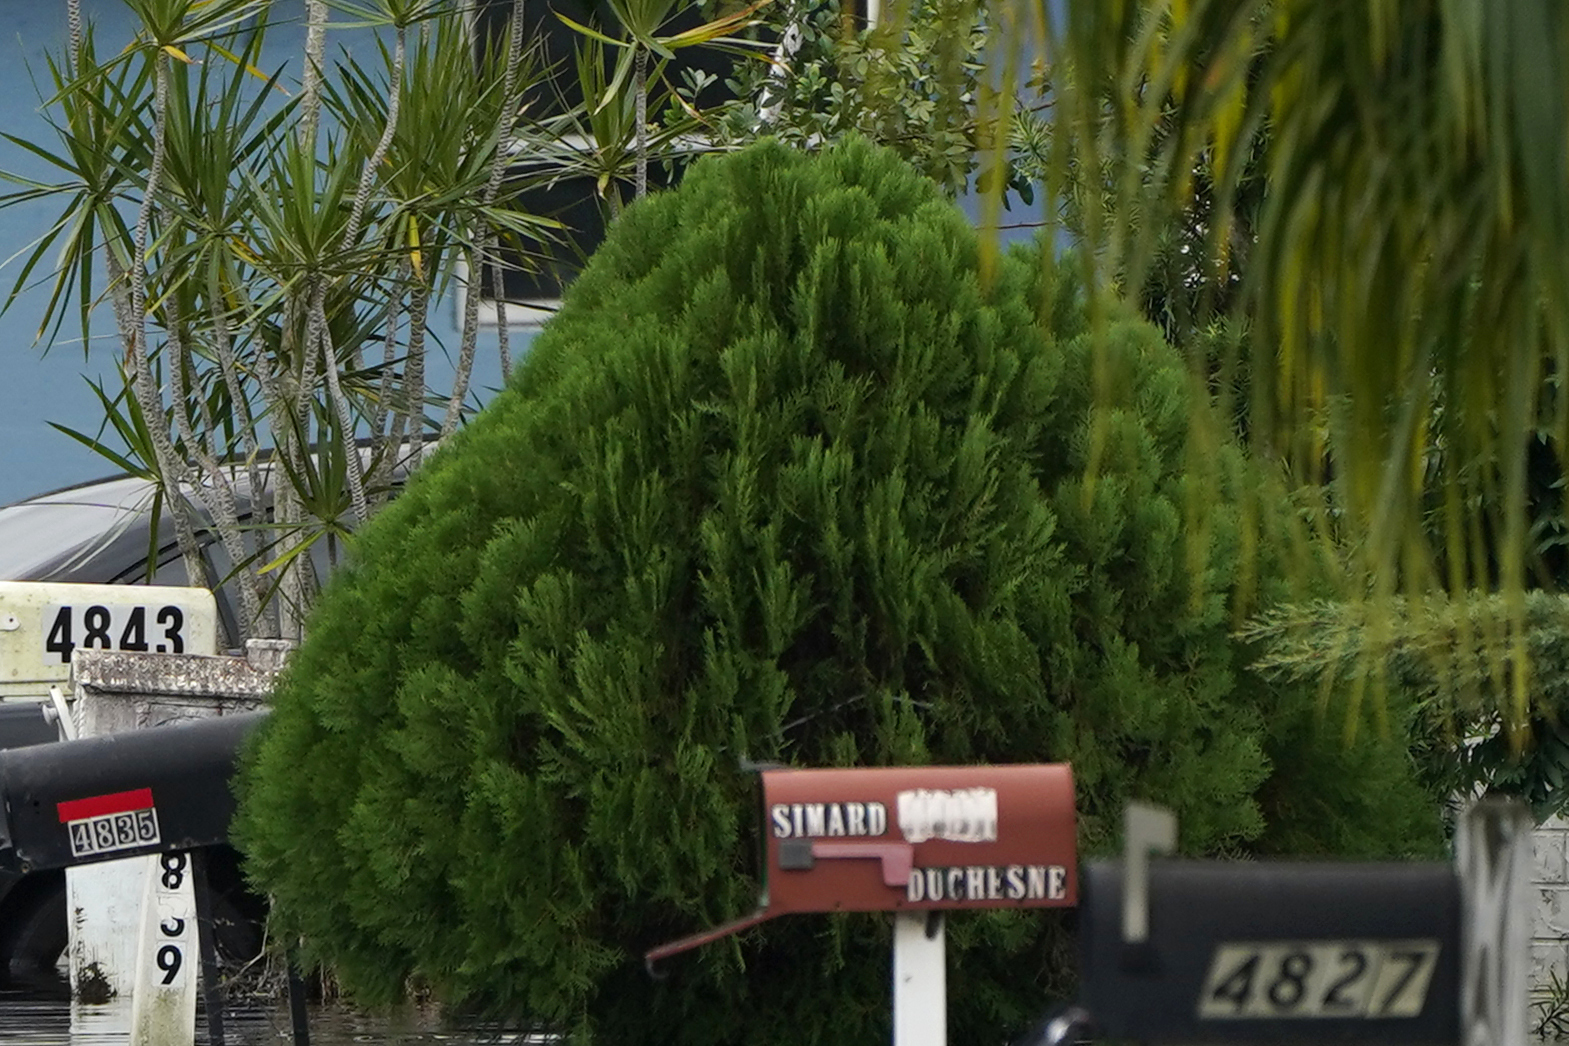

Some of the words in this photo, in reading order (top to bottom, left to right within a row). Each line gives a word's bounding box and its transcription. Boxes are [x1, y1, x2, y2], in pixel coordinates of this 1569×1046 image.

[45, 604, 184, 664] 4843
[74, 810, 155, 853] 4835
[771, 801, 888, 839] SIMARD
[906, 864, 1068, 902] DUCHESNE
[1212, 951, 1427, 1012] 4827
